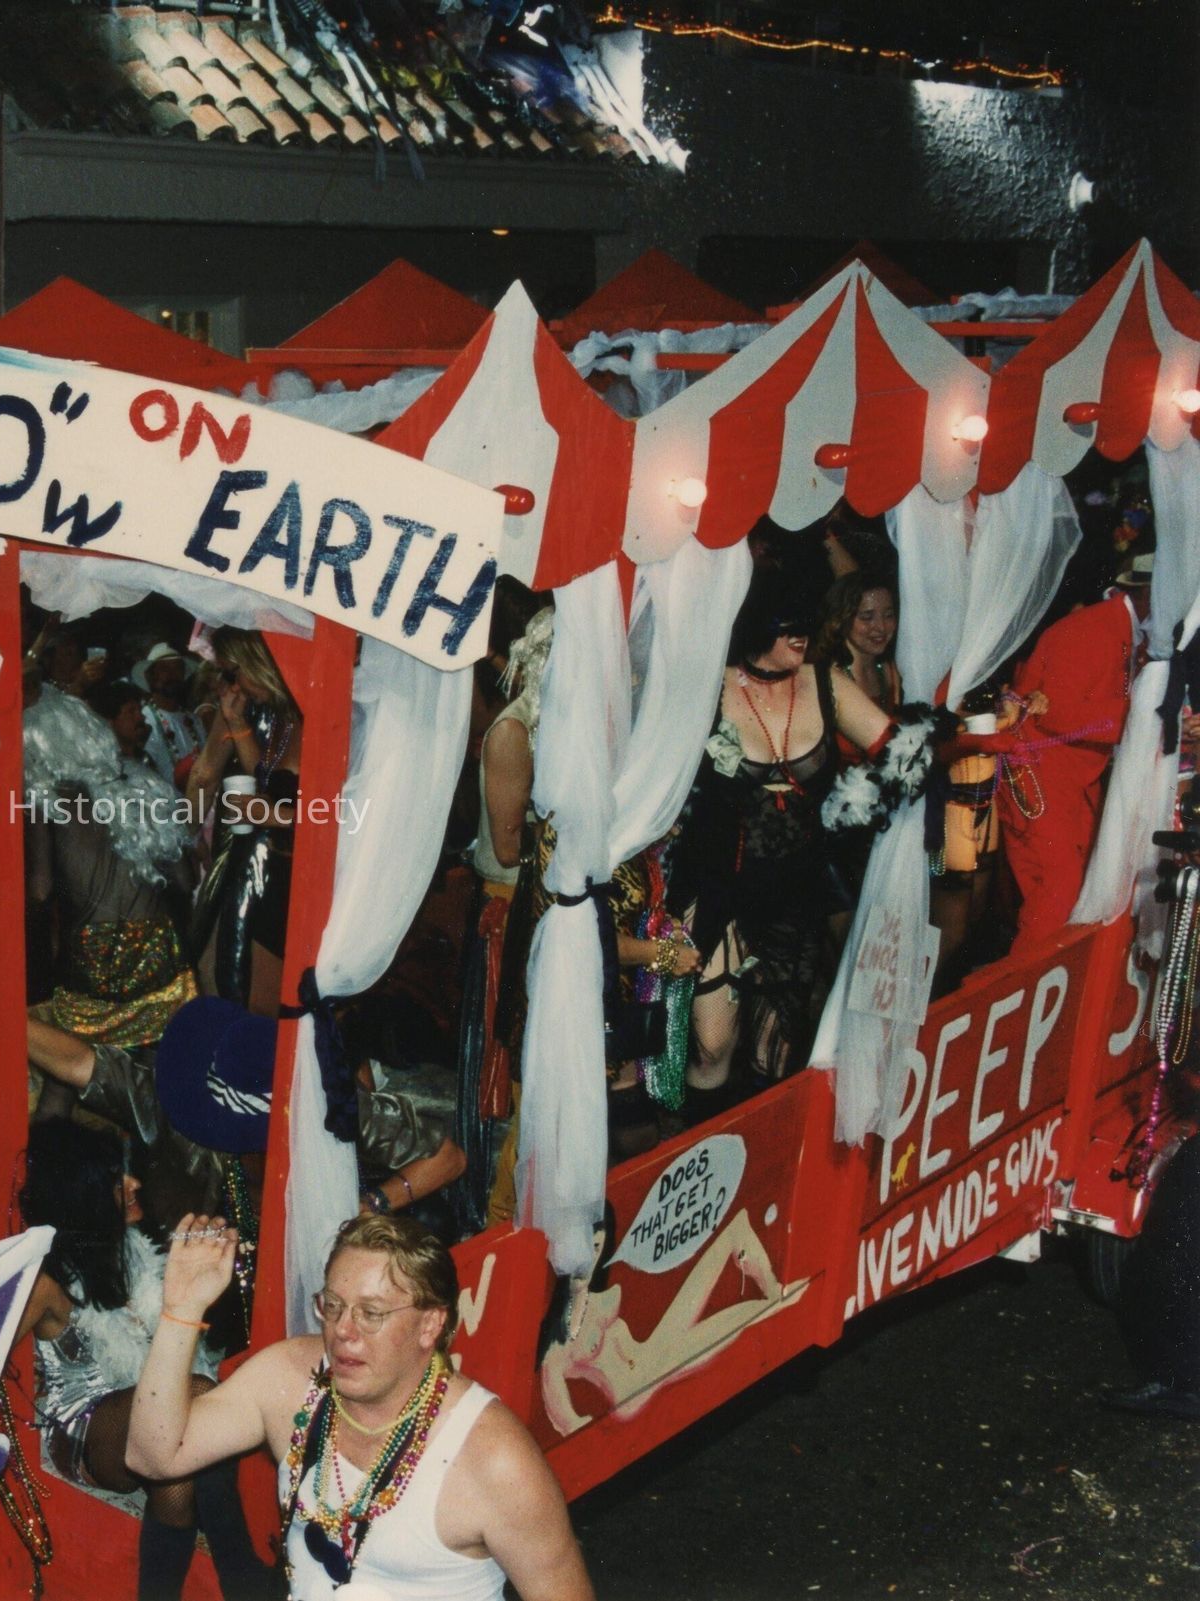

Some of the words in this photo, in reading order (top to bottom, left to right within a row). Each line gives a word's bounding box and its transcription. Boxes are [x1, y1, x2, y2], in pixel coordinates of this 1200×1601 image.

[129, 389, 252, 464] ON
[184, 470, 498, 656] EARTH
[879, 965, 1069, 1206] PEEP
[631, 1198, 675, 1248] THAT
[674, 1173, 714, 1218] GET
[653, 1186, 727, 1263] BIGGER?
[916, 1157, 1001, 1273] NUDE
[1004, 1117, 1063, 1198] GUYS
